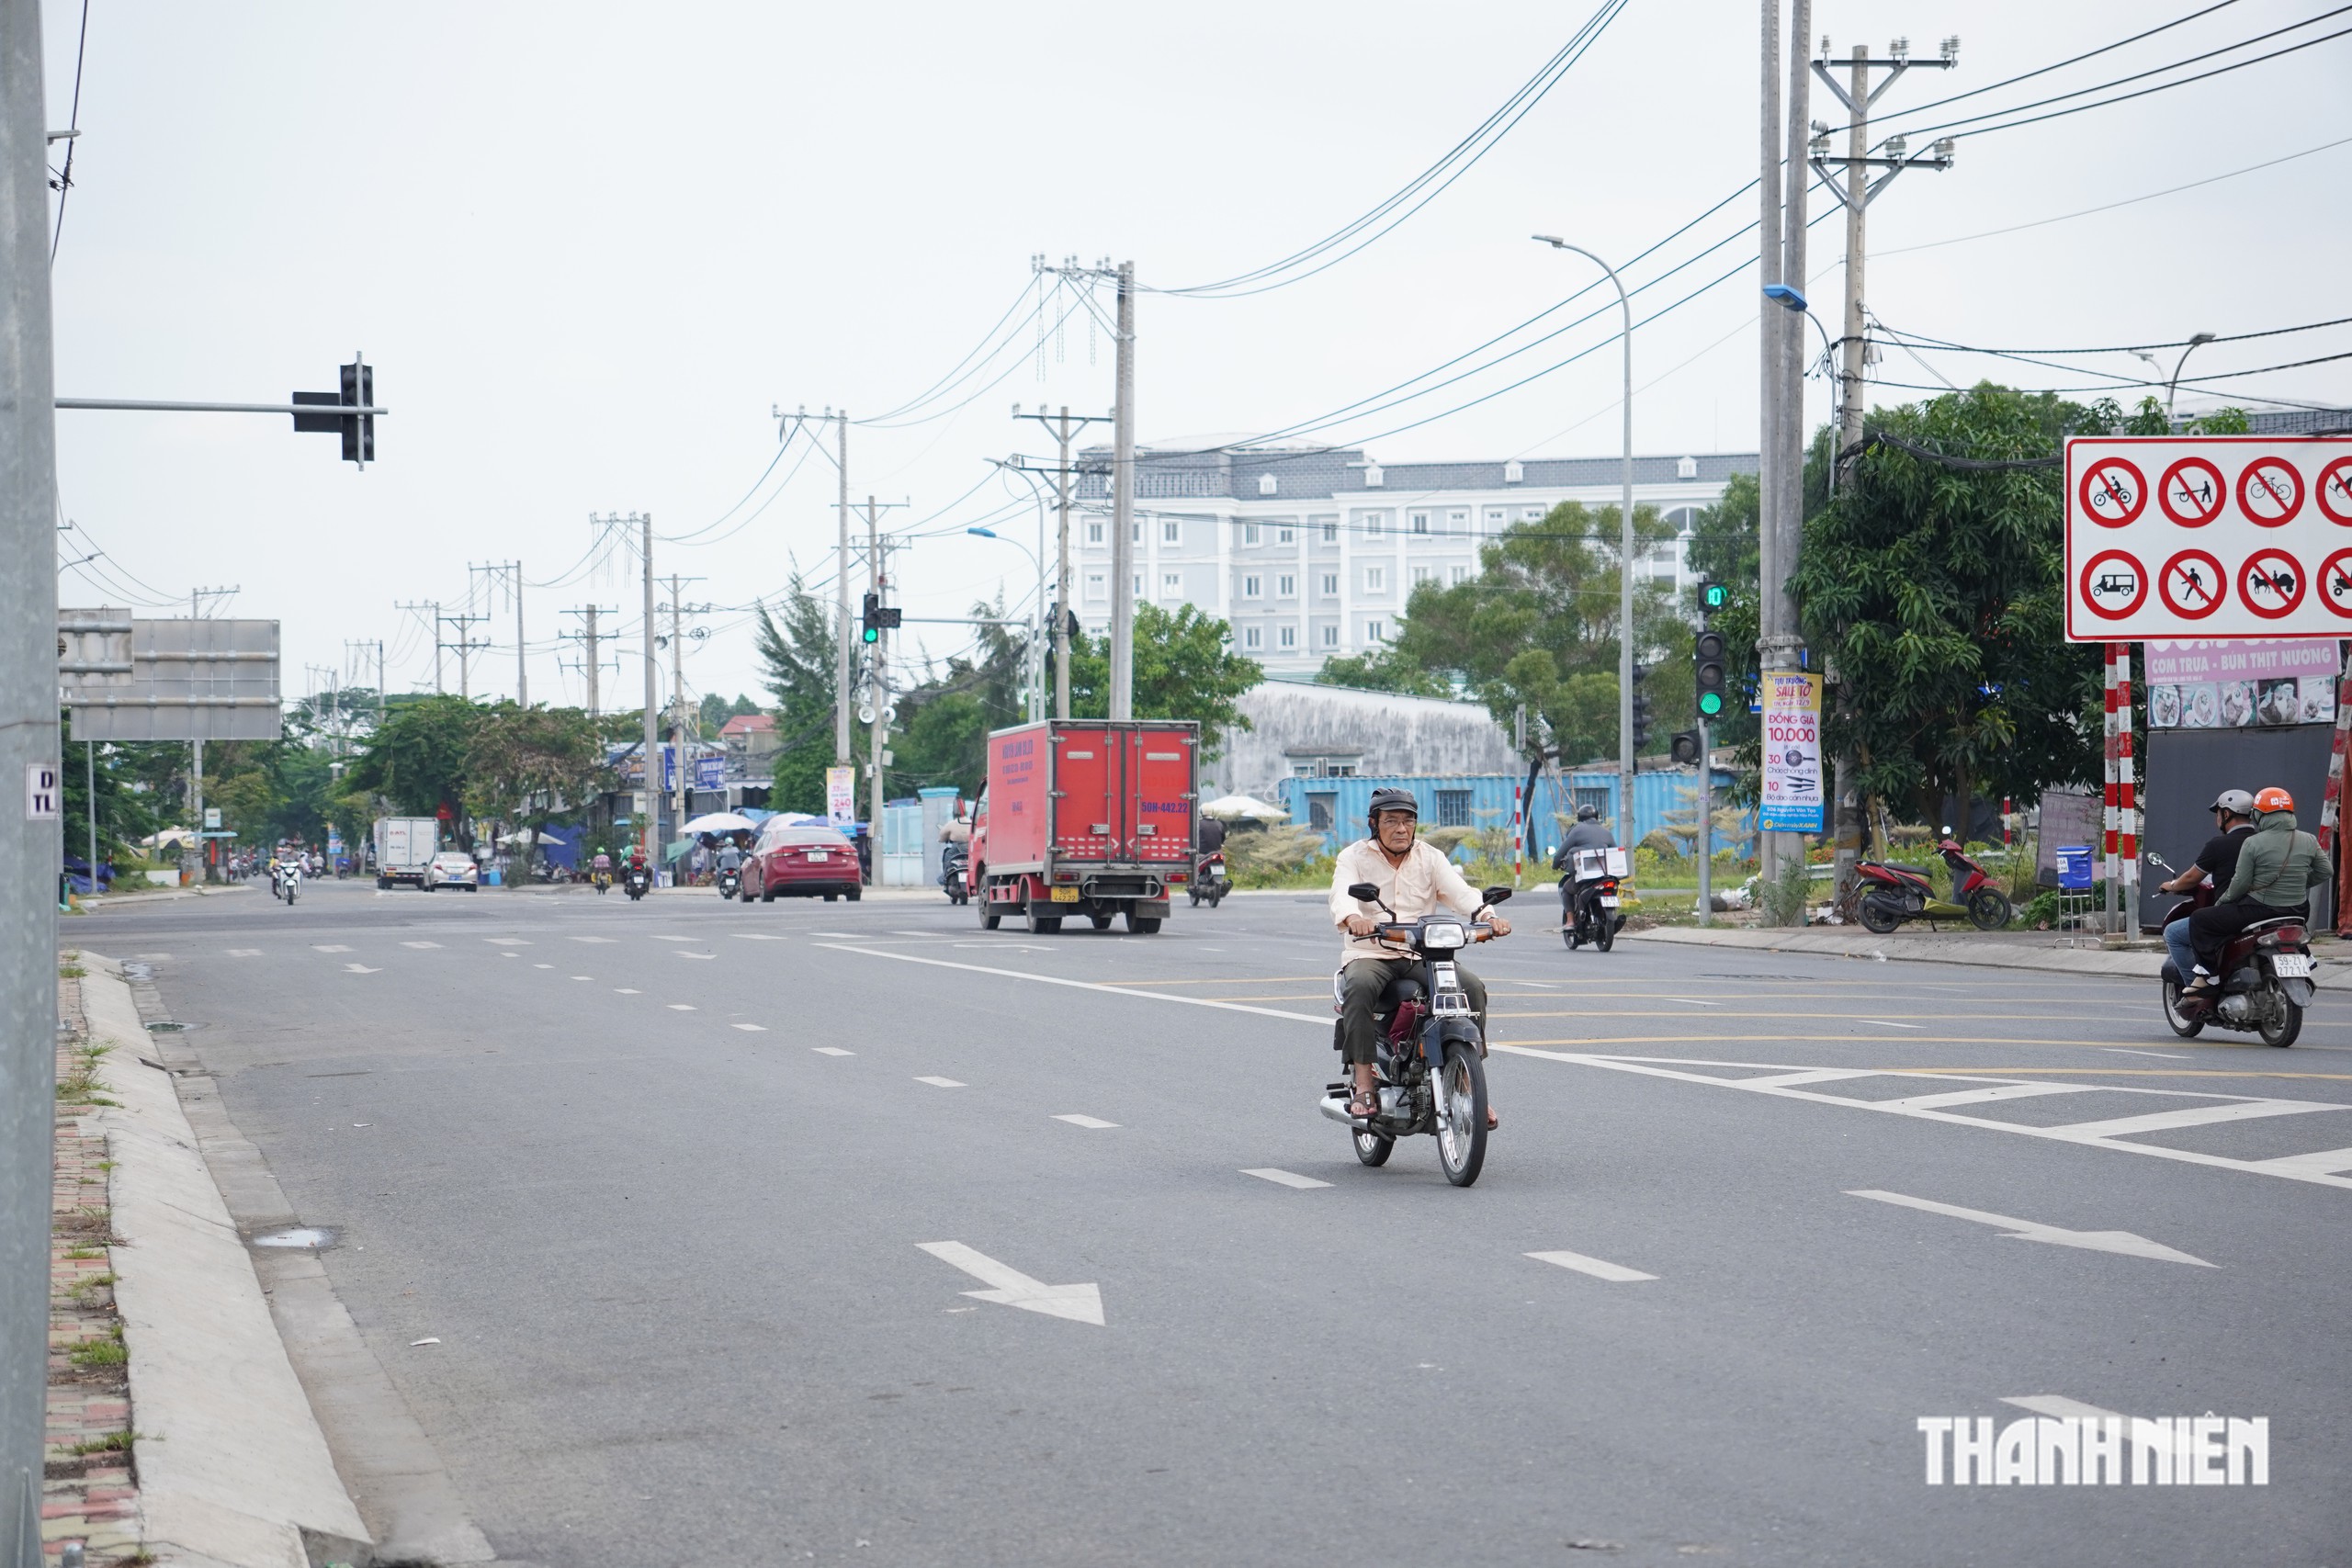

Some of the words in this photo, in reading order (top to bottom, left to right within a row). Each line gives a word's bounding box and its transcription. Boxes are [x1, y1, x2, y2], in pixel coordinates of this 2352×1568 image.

[1708, 587, 1721, 605] 10
[2221, 650, 2246, 671] BÚN
[2250, 651, 2278, 671] THỊT
[1776, 685, 1795, 697] SALE
[1769, 712, 1797, 724] ĐỒNG
[1800, 715, 1815, 725] GIÁ
[1768, 727, 1815, 742] 10.000
[1768, 754, 1781, 764] 30
[1768, 782, 1779, 792] 10
[1141, 802, 1188, 813] 50H-442.22
[2278, 956, 2301, 964] 59-Z1
